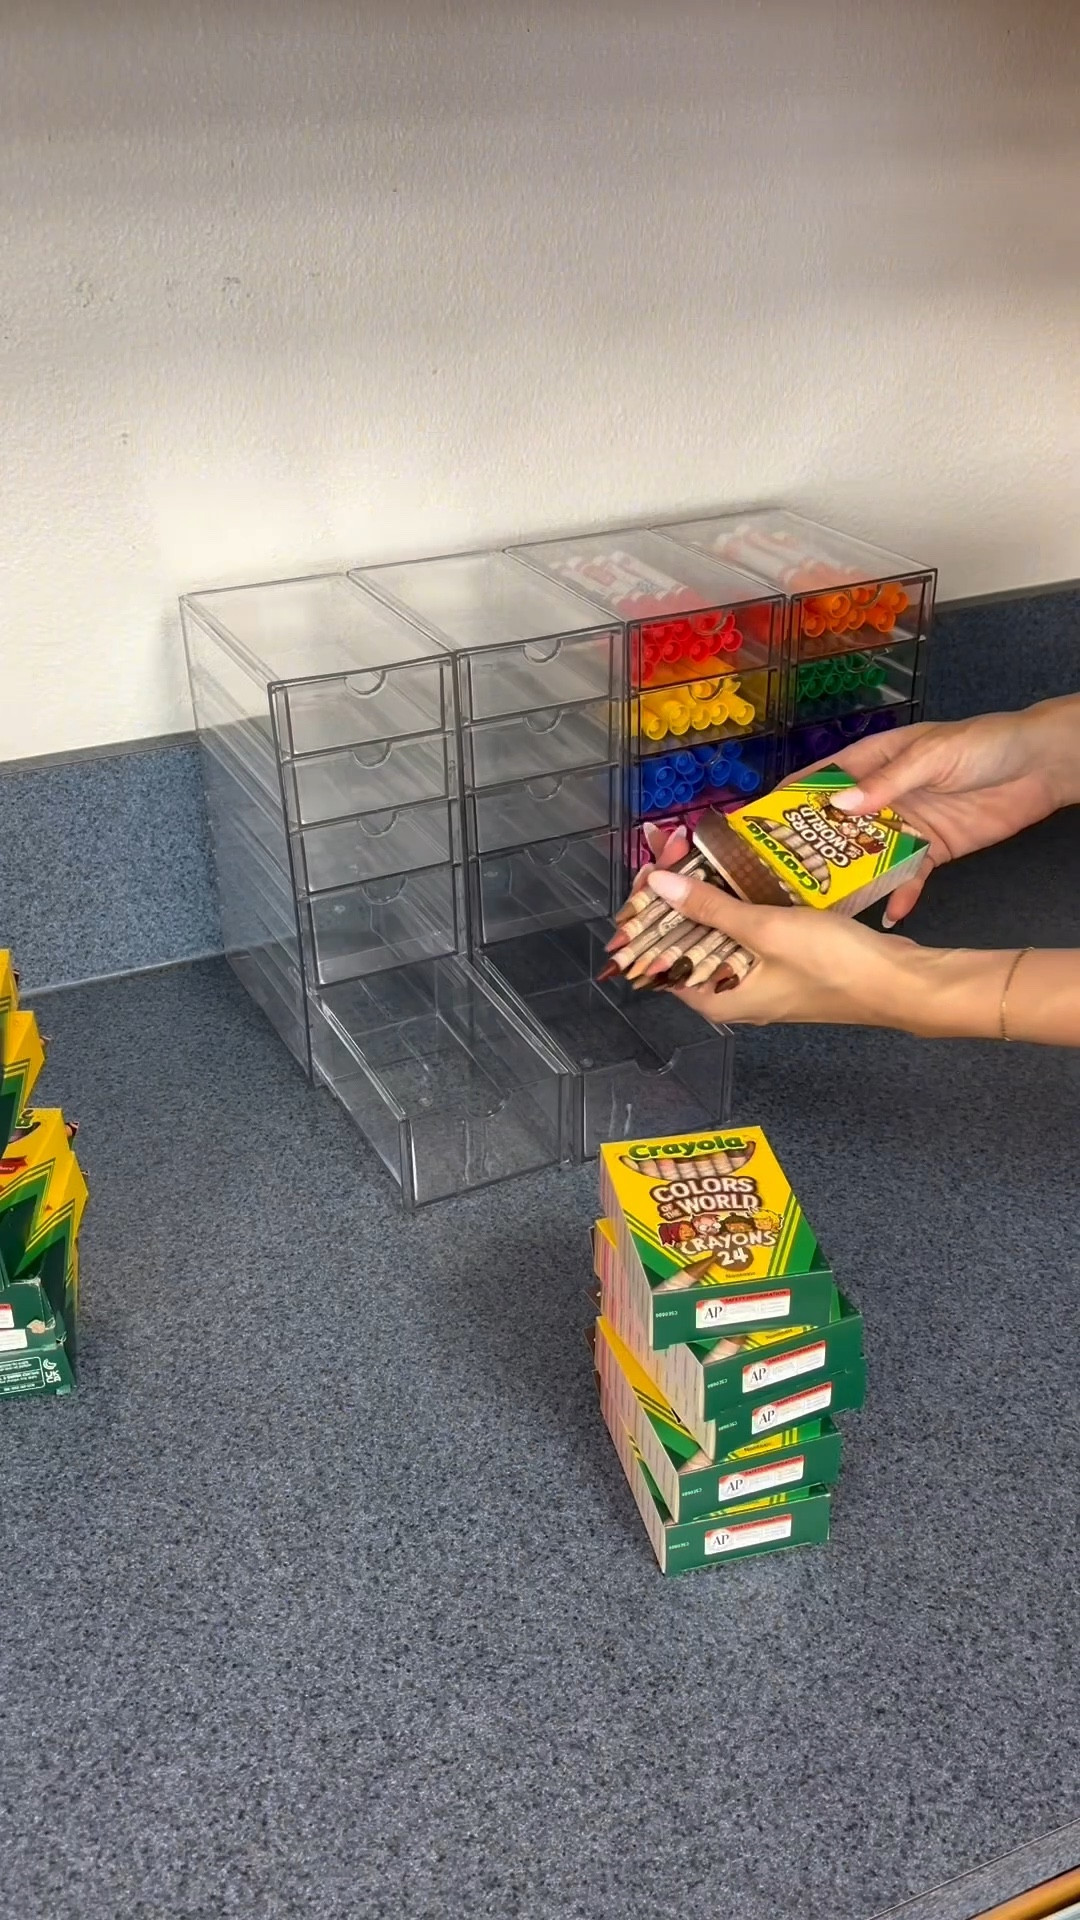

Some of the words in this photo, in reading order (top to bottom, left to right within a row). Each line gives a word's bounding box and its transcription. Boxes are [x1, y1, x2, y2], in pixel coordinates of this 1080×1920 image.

[784, 810, 849, 867] COLORS
[800, 805, 849, 851] WORLD
[746, 821, 819, 892] Crayola
[628, 1135, 745, 1159] Crayola
[653, 1177, 755, 1203] COLORS
[660, 1203, 673, 1213] OF
[677, 1193, 760, 1214] WORLD
[681, 1230, 778, 1255] CRAYONS
[717, 1247, 749, 1266] 24
[704, 1305, 723, 1320] AP
[749, 1367, 767, 1382] AP
[758, 1409, 776, 1424] AP
[726, 1478, 744, 1492] AP
[712, 1533, 730, 1547] AP
